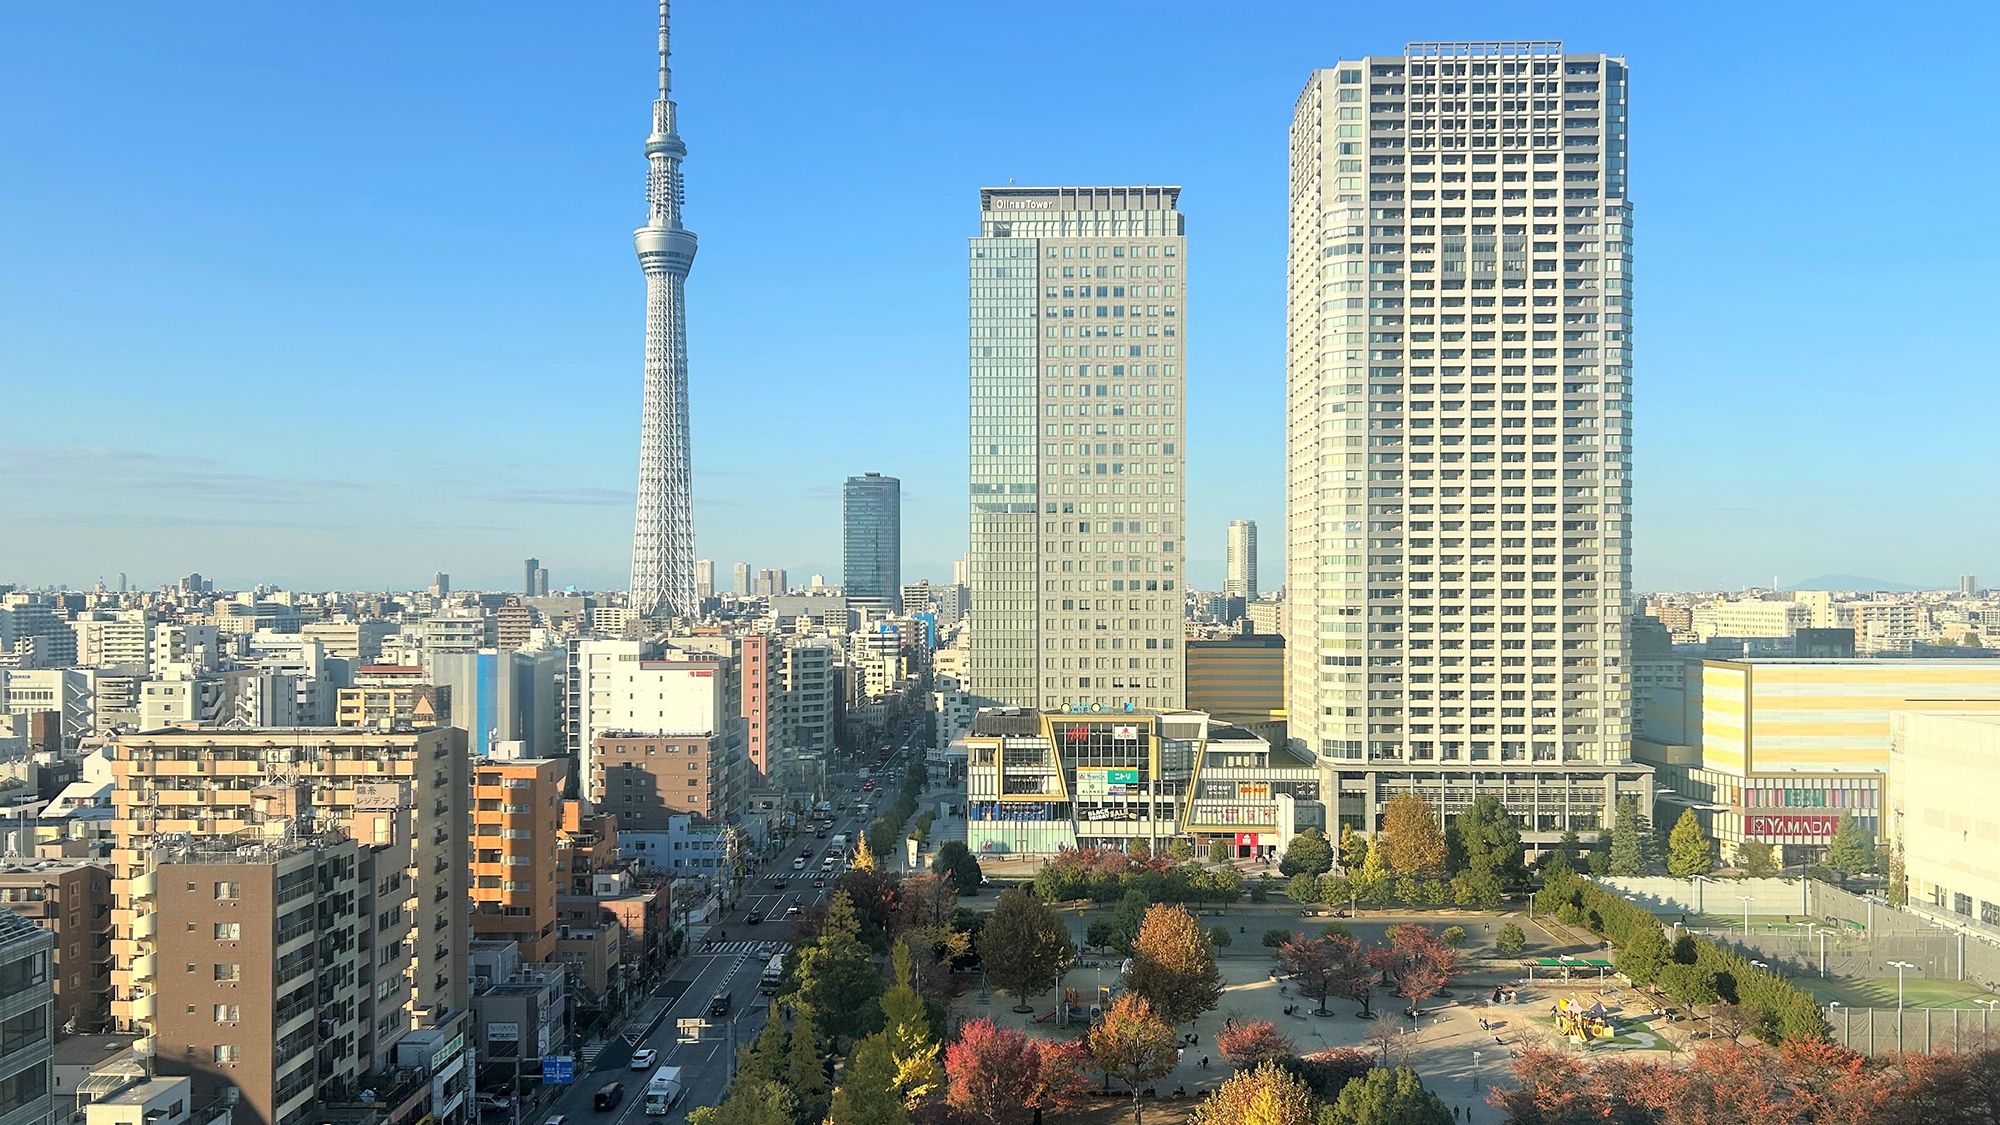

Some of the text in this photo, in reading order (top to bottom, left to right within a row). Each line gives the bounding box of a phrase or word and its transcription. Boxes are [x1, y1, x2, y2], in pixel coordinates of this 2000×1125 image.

[1026, 199, 1053, 209] Tower
[1114, 772, 1131, 780] ニトリ
[356, 796, 397, 804] レジデンス
[1767, 818, 1832, 834] YAMADA
